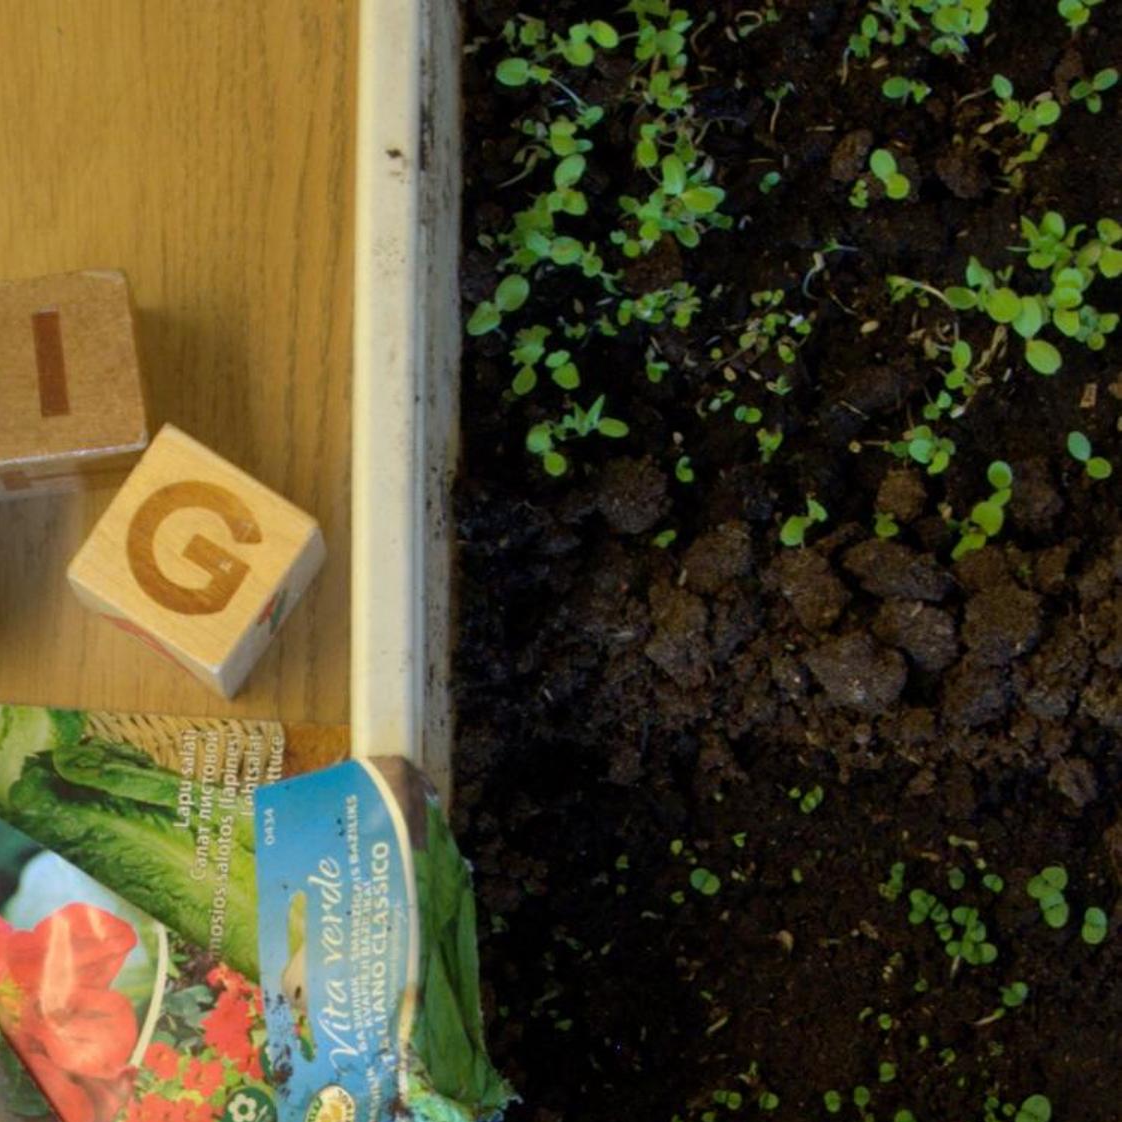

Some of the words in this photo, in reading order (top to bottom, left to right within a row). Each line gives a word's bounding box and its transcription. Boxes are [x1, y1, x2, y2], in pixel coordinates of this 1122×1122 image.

[32, 311, 70, 417] I
[127, 481, 263, 616] G
[173, 780, 195, 828] Lapu
[265, 734, 284, 783] ttuce
[264, 807, 275, 846] 0434
[307, 856, 342, 968] verde
[371, 841, 387, 955] CLASSICO
[316, 977, 358, 1074] Vita
